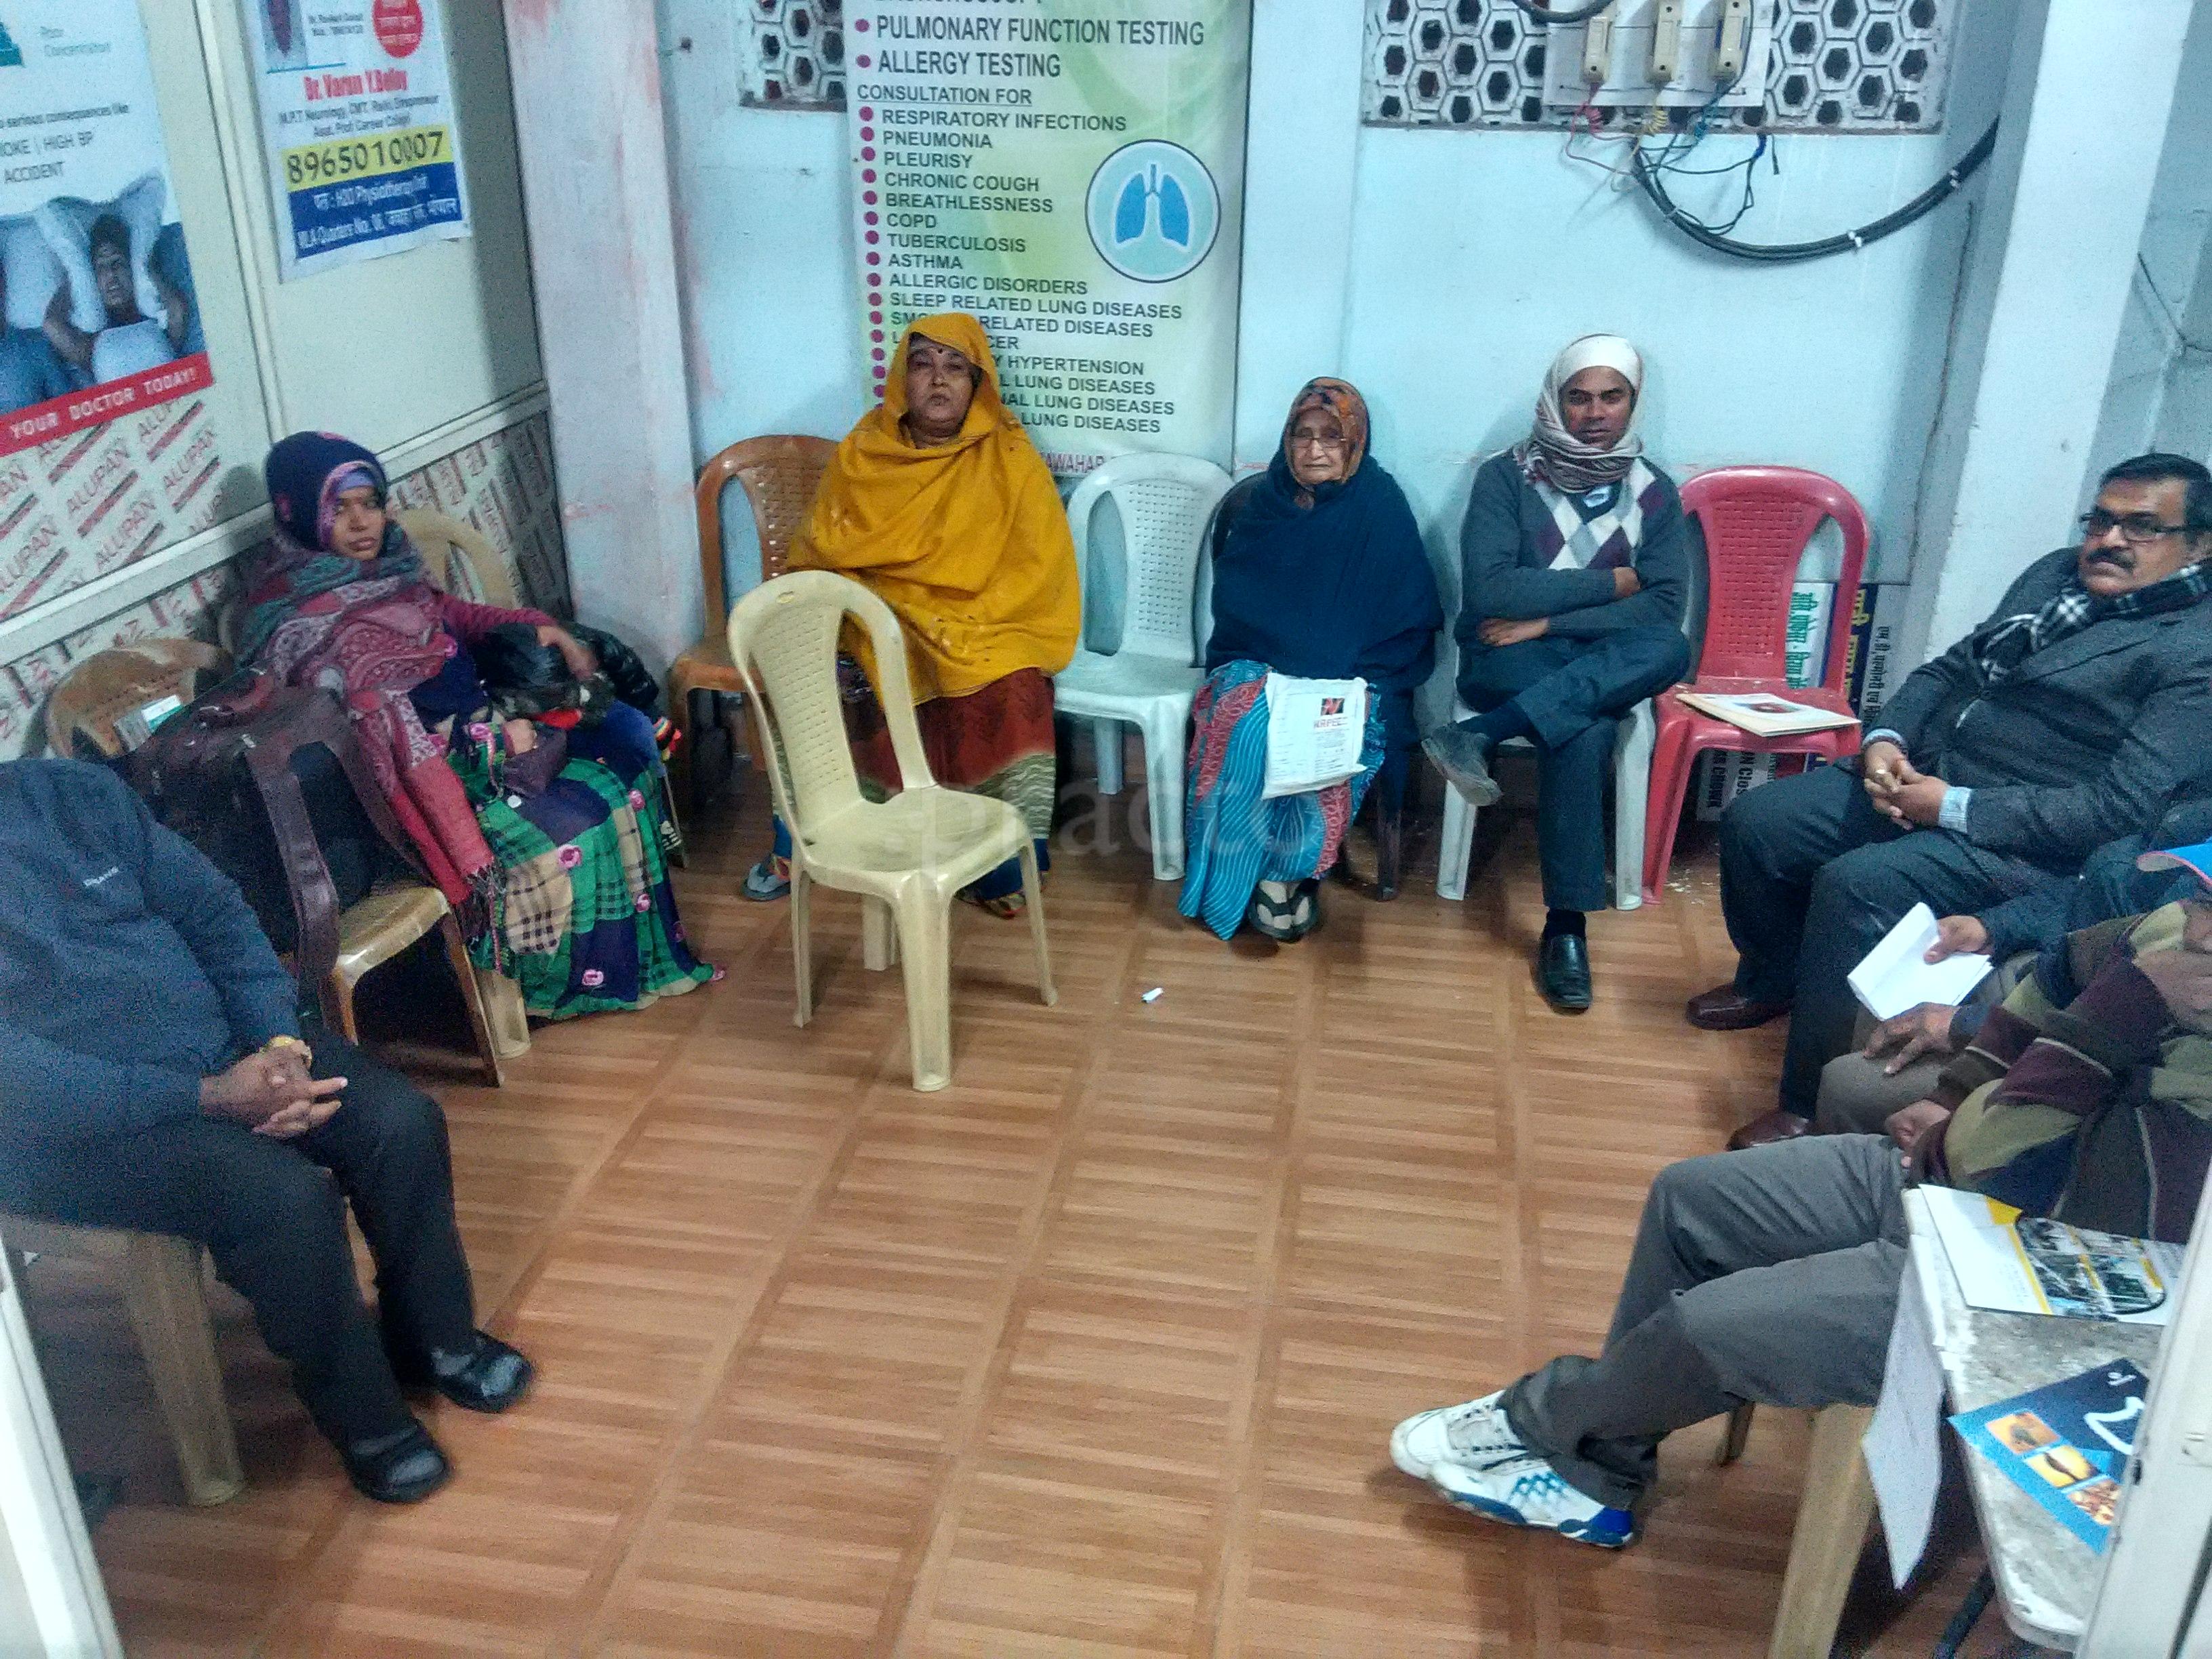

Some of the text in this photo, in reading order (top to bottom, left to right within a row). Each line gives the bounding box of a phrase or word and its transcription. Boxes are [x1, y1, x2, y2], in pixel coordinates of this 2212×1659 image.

[877, 15, 1204, 45] PULMONARY FUNCTION TESTING
[878, 49, 1061, 77] ALLERGY TESTING
[857, 84, 1032, 104] CONSULTATION FOR
[882, 109, 1127, 131] RESPIRATORY INFECTIONS
[882, 130, 993, 148] PNEUMONIA
[884, 151, 974, 169] PLEURISY
[884, 172, 1040, 192] CHRONIC COUGH
[886, 192, 1053, 213] BREATHLESSNESS
[886, 213, 937, 228] COPD
[886, 232, 1027, 253] TUBERCULOSIS
[888, 253, 963, 270] ASTHMA
[889, 273, 1088, 295] ALLERGIC DISORDERS
[889, 292, 1183, 319] SLEEP RELATED LUNG DISEASES
[980, 315, 1059, 333] RELATED
[1065, 319, 1153, 337] DISEASES
[1008, 356, 1145, 375] HYPERTENSION
[1017, 375, 1063, 391] LUNG
[1068, 377, 1155, 395] DISEASES
[1035, 394, 1082, 410] LUNG
[1088, 397, 1175, 415] DISEASES
[1021, 411, 1161, 434] LUNG DISEASES
